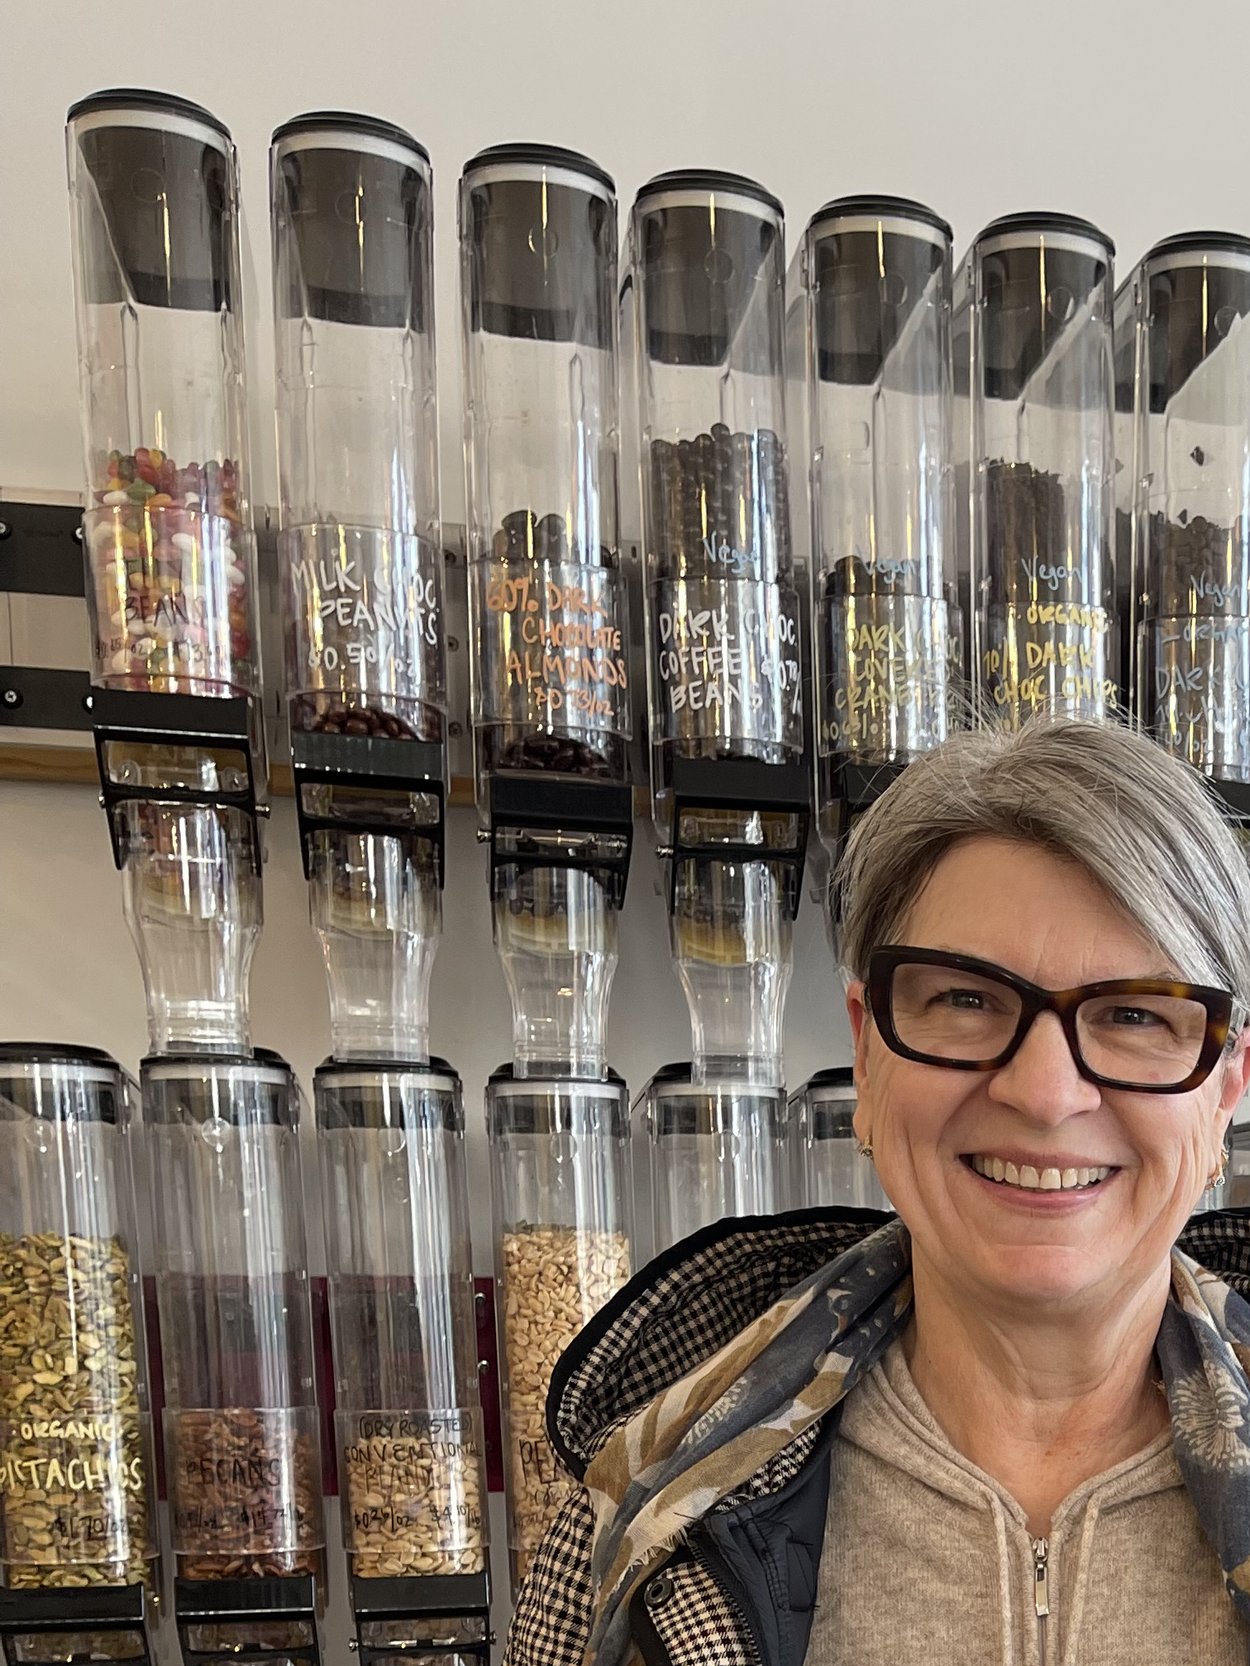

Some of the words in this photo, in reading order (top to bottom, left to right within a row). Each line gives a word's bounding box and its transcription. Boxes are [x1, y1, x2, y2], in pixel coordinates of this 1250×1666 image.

[1021, 554, 1083, 591] Vegan
[522, 616, 621, 651] CHOCOLATE
[660, 609, 735, 645] DARK
[508, 650, 627, 690] ALMONDS
[659, 645, 742, 682] COFFEE
[670, 679, 763, 714] BEANS
[993, 675, 1047, 705] CHOC
[21, 1420, 122, 1442] ORGANIC
[344, 1441, 482, 1463] CONVENTIONAL
[186, 1457, 281, 1487] PECANS
